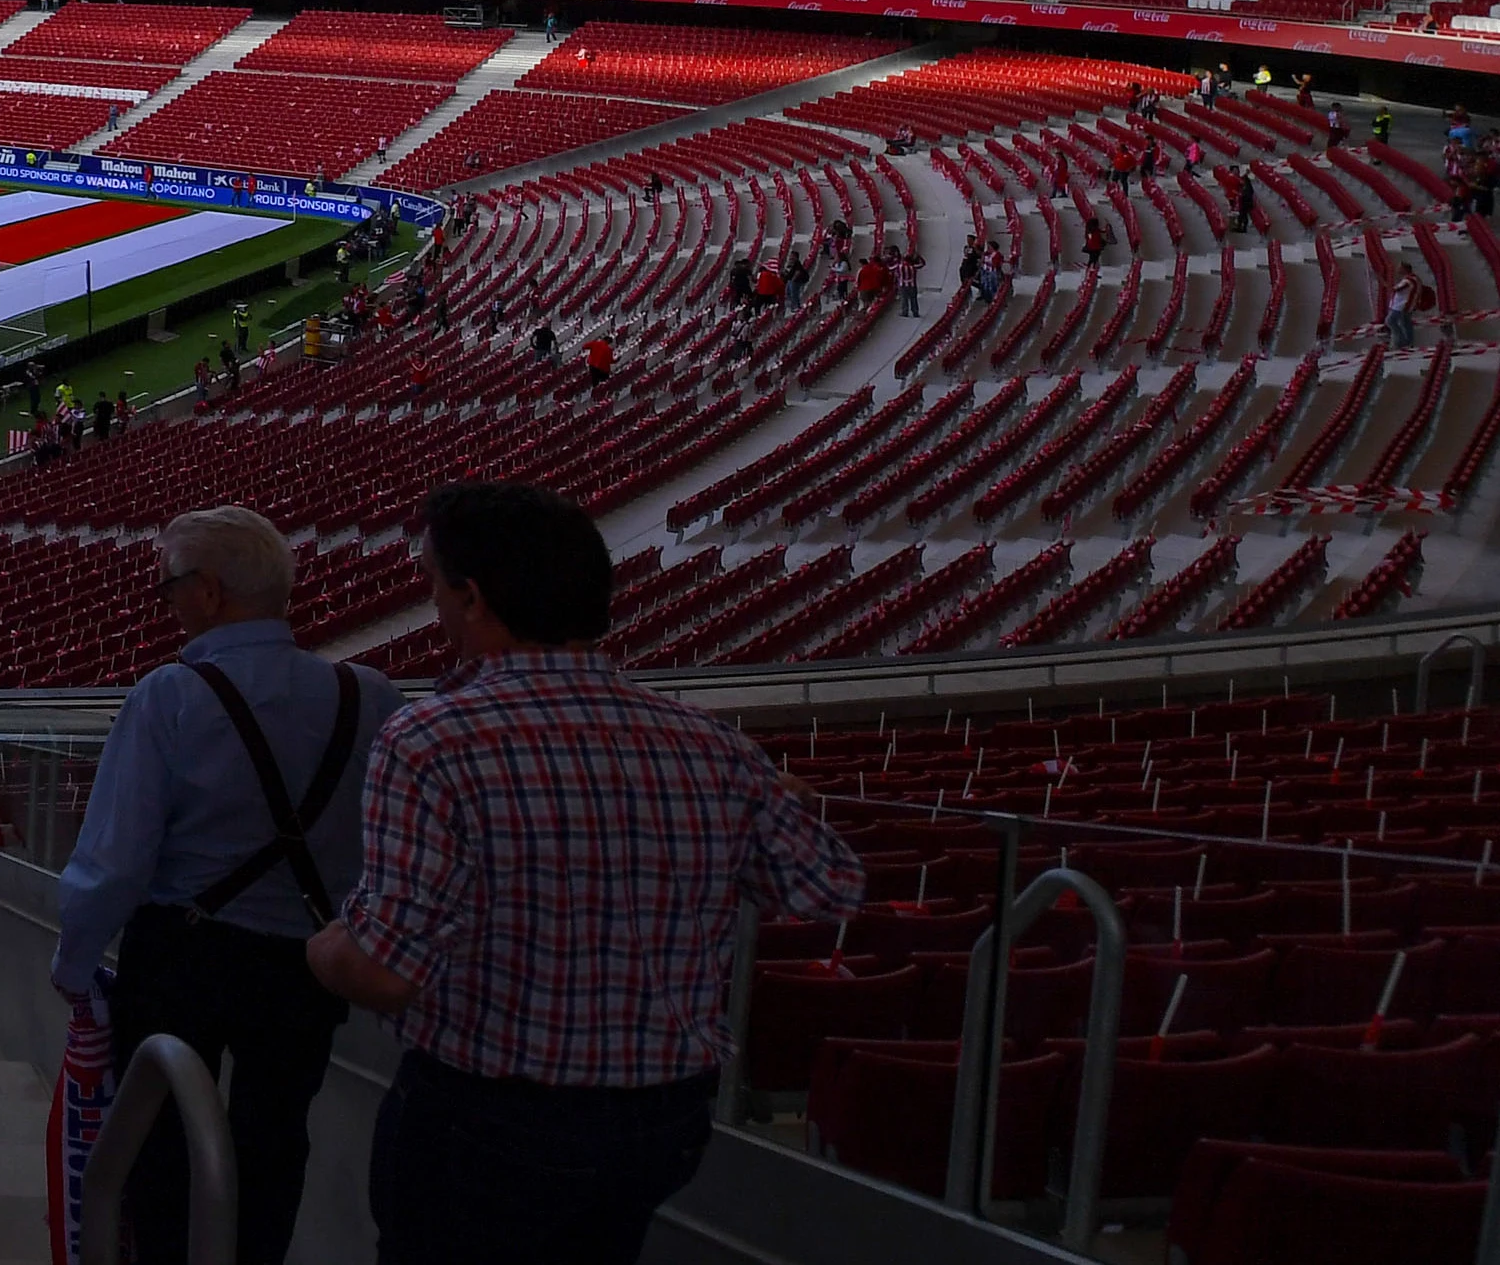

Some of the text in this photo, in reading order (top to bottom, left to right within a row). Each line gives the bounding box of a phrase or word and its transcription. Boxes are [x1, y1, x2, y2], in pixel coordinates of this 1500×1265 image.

[101, 160, 142, 174] Mahou
[153, 165, 197, 181] Mahou
[19, 167, 61, 183] SPONSOR
[61, 174, 73, 184] OF
[86, 175, 129, 190] WANDA
[287, 197, 336, 213] SPONSOR
[337, 204, 350, 215] OF
